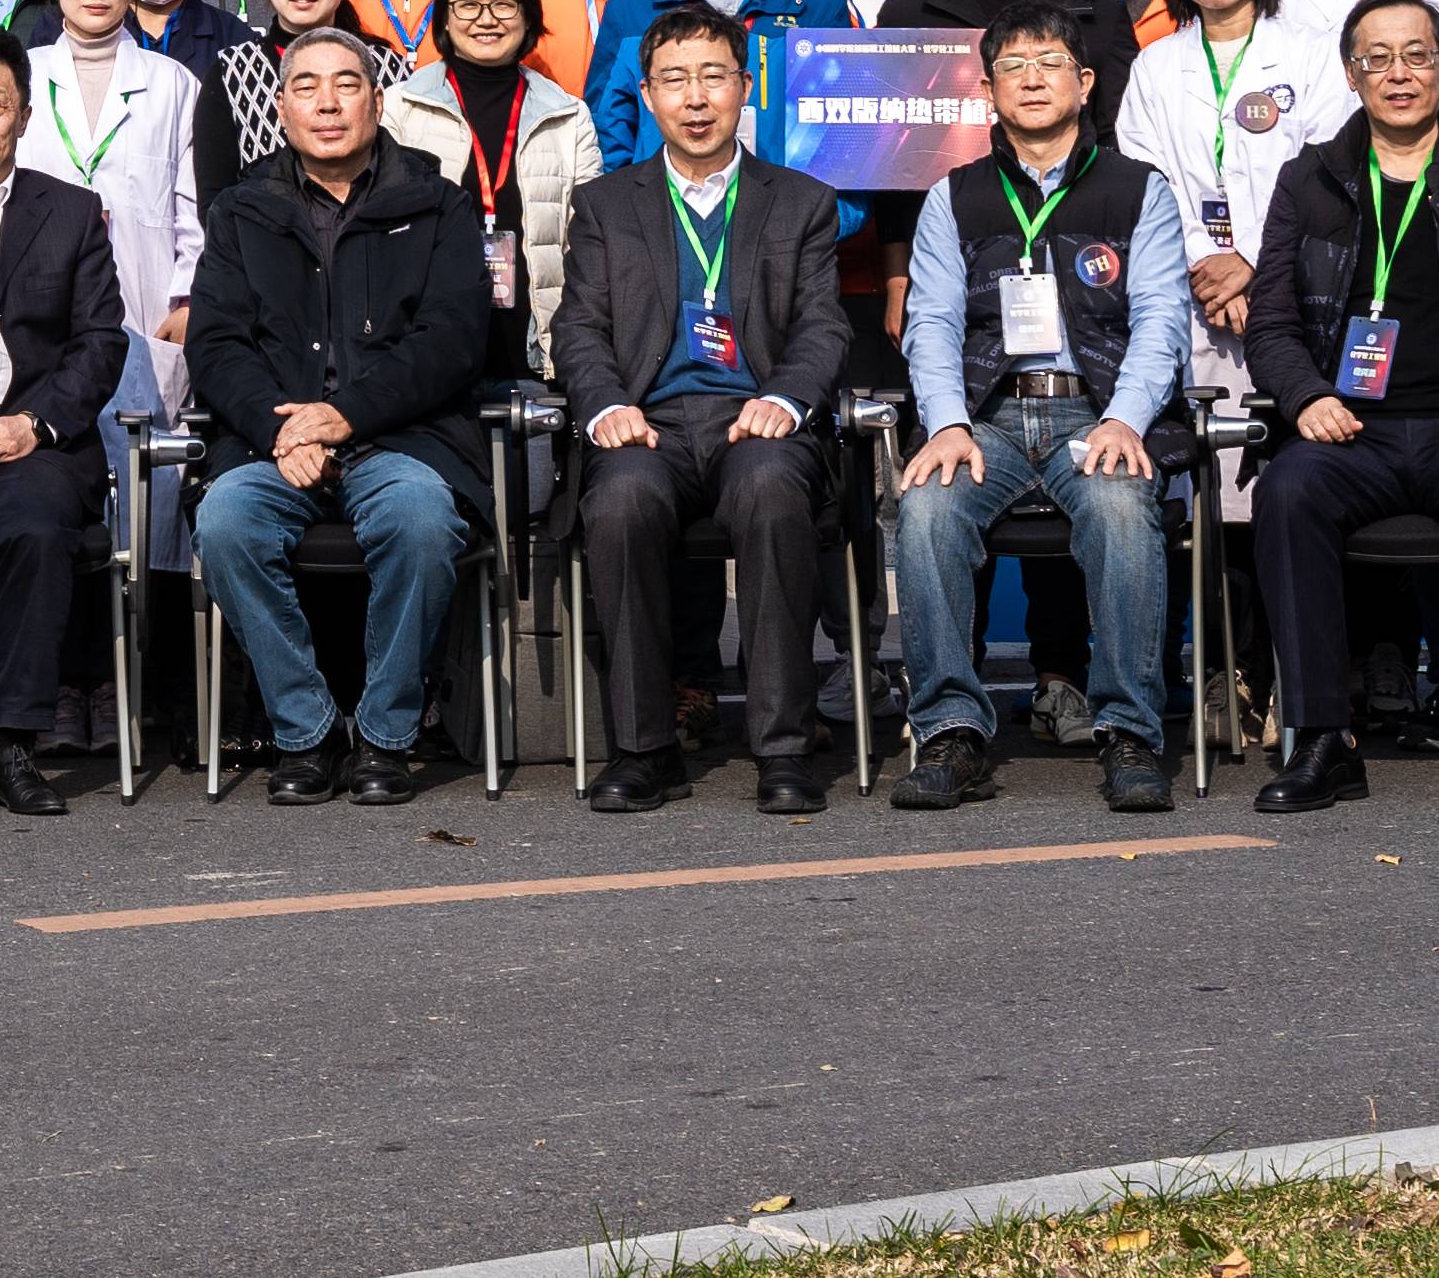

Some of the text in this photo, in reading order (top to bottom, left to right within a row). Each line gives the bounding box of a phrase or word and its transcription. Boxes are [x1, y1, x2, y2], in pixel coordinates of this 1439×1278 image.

[798, 97, 998, 125] 西双版纳热带植
[1245, 105, 1269, 120] H3
[1084, 254, 1111, 276] FH
